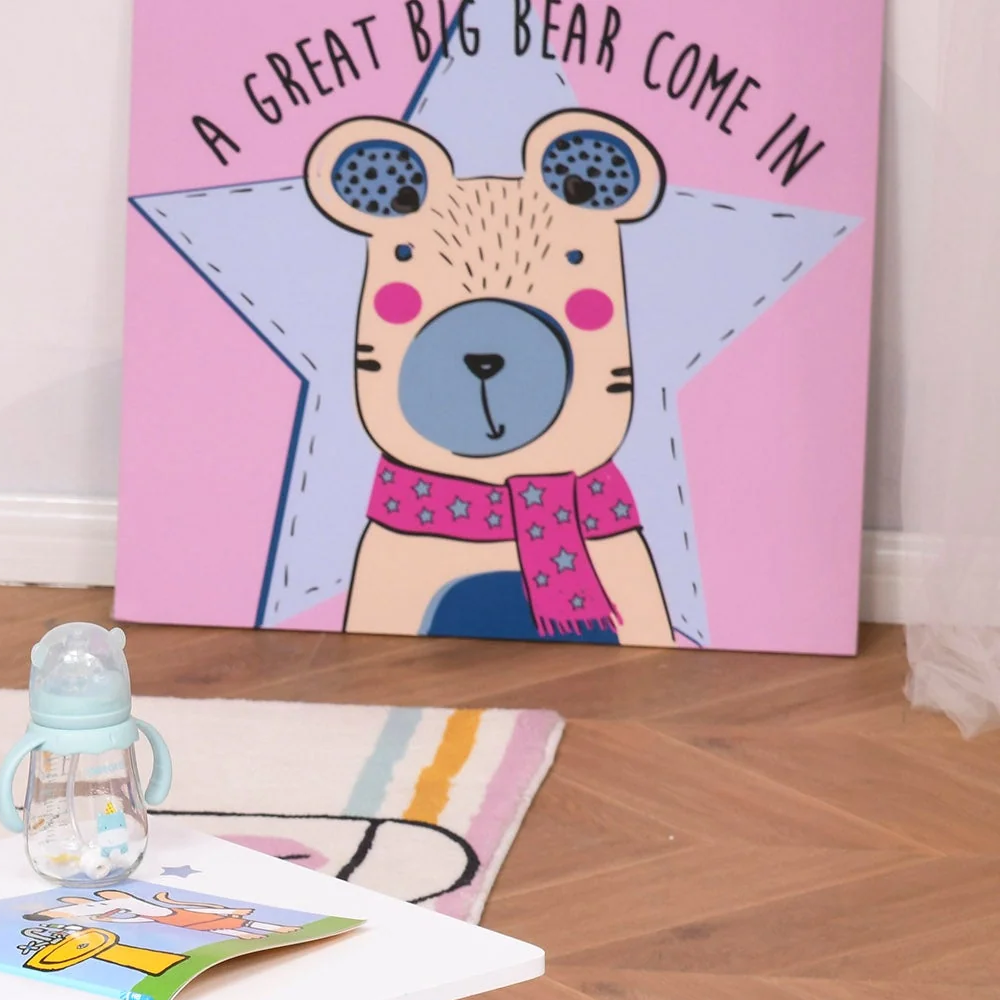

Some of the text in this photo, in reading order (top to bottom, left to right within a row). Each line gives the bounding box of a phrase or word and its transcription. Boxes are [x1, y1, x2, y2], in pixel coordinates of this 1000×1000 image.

[191, 0, 827, 189] A GREAT BIG BEAR COME IN
